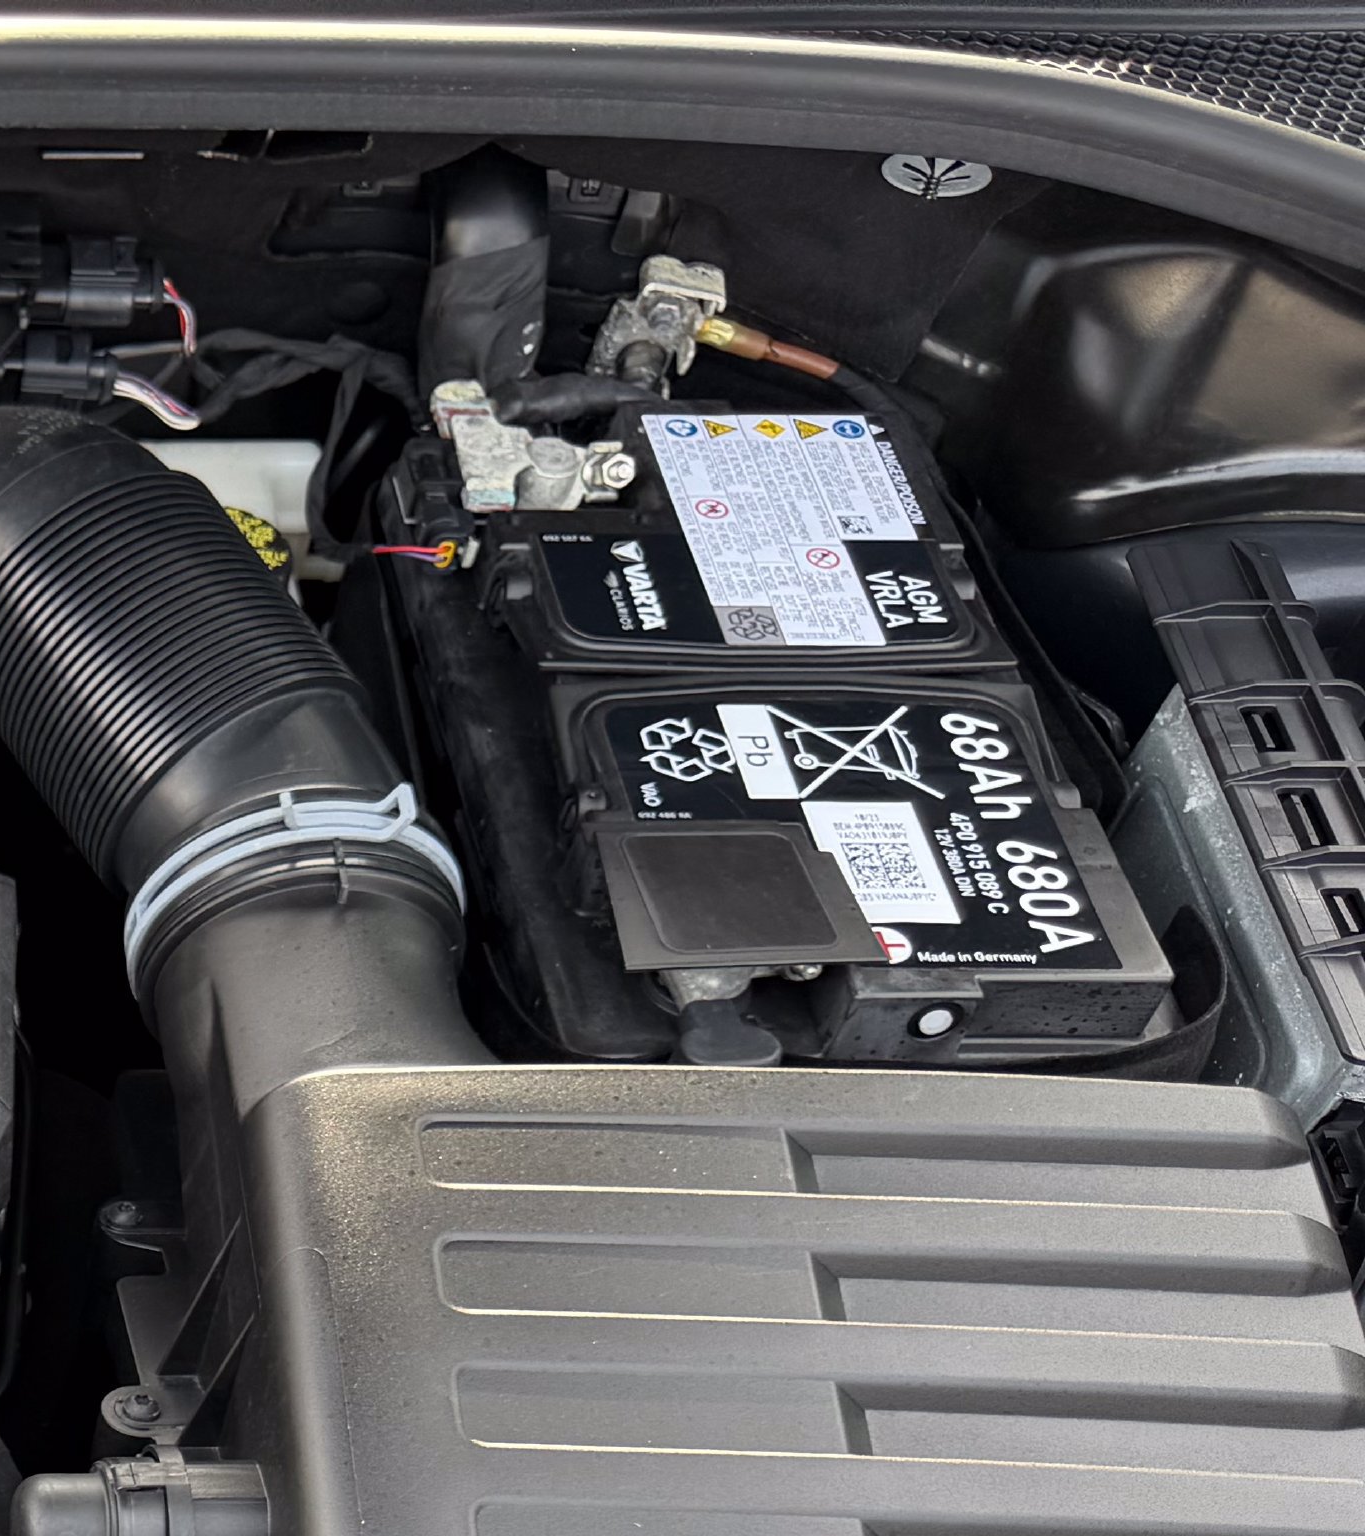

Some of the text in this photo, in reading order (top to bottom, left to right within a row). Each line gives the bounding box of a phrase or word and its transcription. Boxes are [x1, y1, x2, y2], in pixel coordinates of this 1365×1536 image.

[876, 441, 926, 525] DANGER/POISON
[609, 589, 635, 631] CLARIOS
[623, 563, 665, 630] VARTA
[865, 570, 914, 629] VRLA
[899, 574, 948, 624] AGM
[736, 734, 775, 767] Pb
[933, 828, 976, 897] 12V 380A DIN
[940, 713, 1096, 954] 68Ah 680A
[949, 812, 1010, 914] 4P0 915 089 C
[917, 951, 1037, 965] Made in Germany
